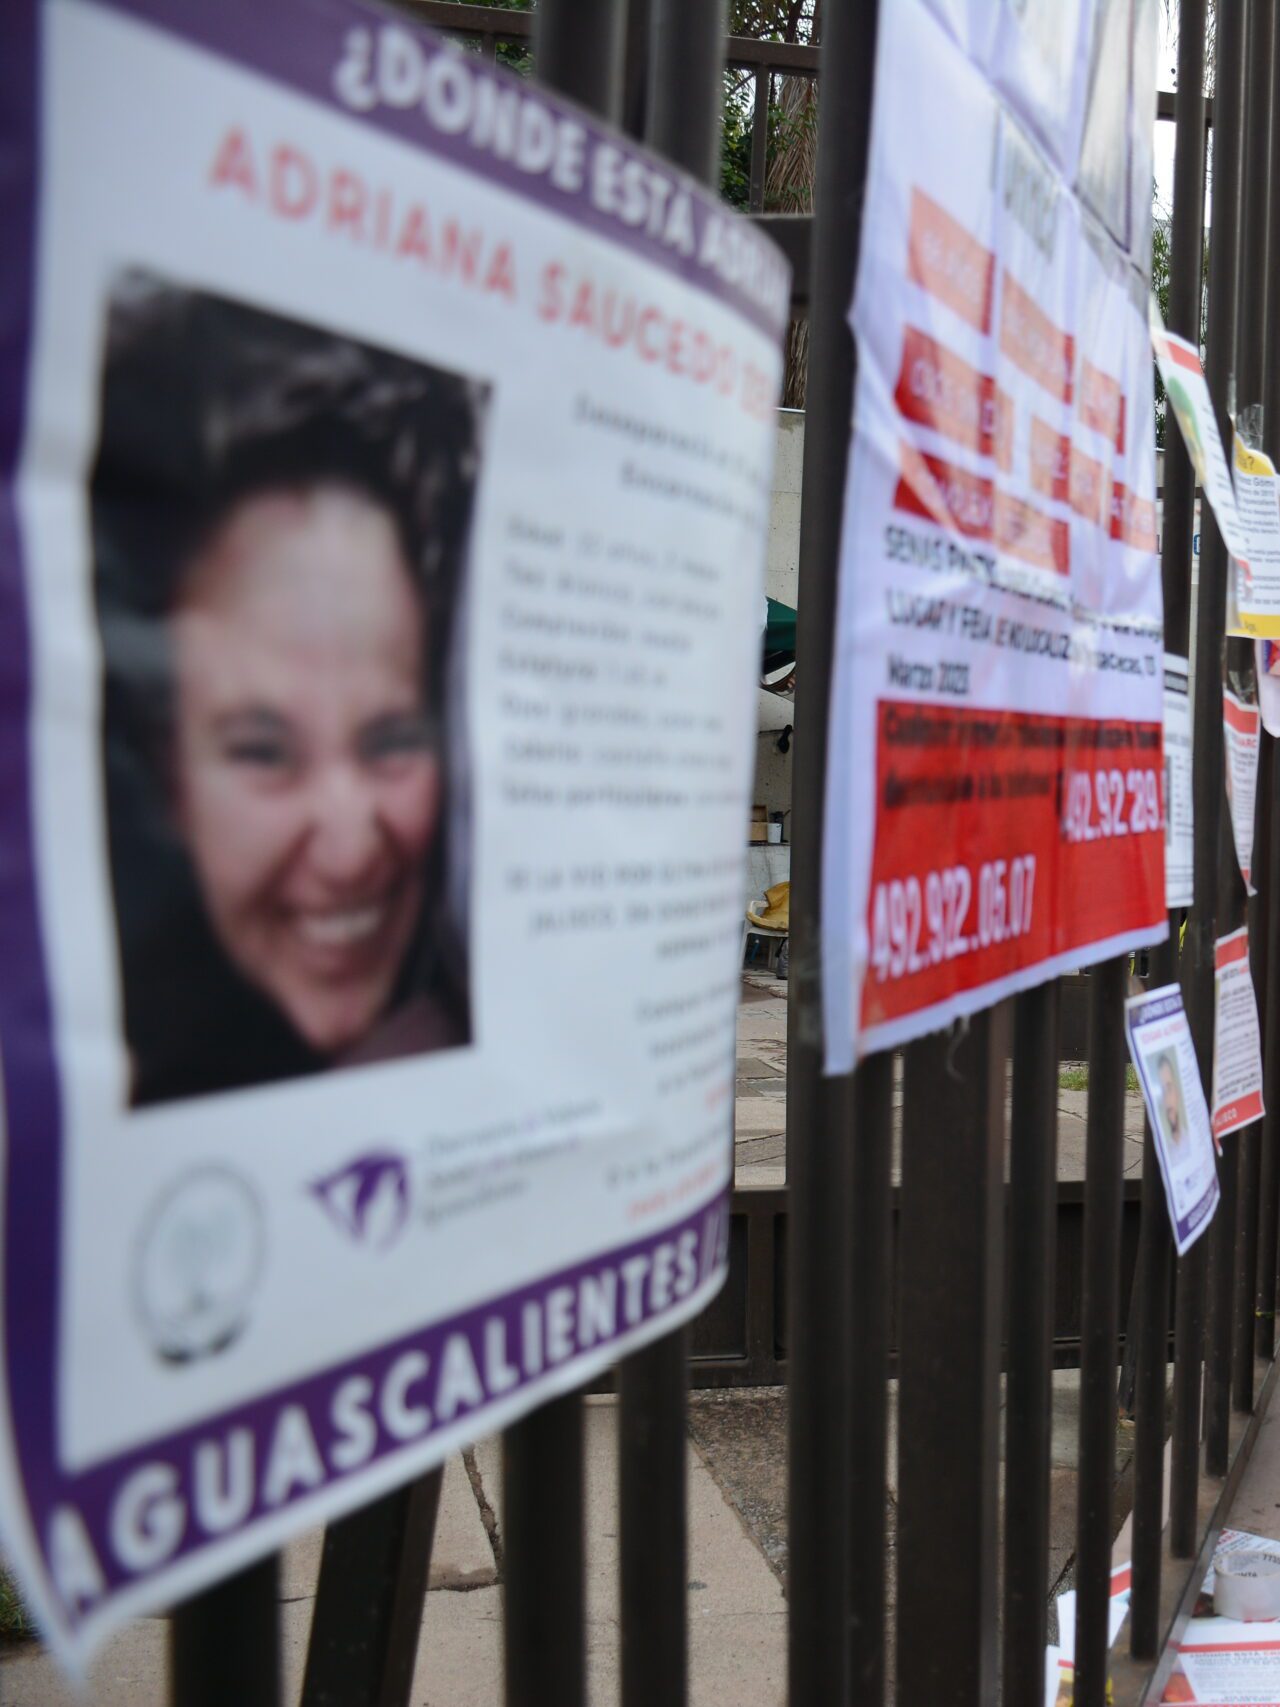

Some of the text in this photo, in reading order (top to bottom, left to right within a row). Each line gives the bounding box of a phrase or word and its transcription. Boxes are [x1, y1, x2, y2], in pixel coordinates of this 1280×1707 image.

[334, 22, 588, 193] ¿DÓNDE
[208, 122, 517, 305] ADRIANA
[45, 1227, 699, 1620] AGUASCALIENTES
